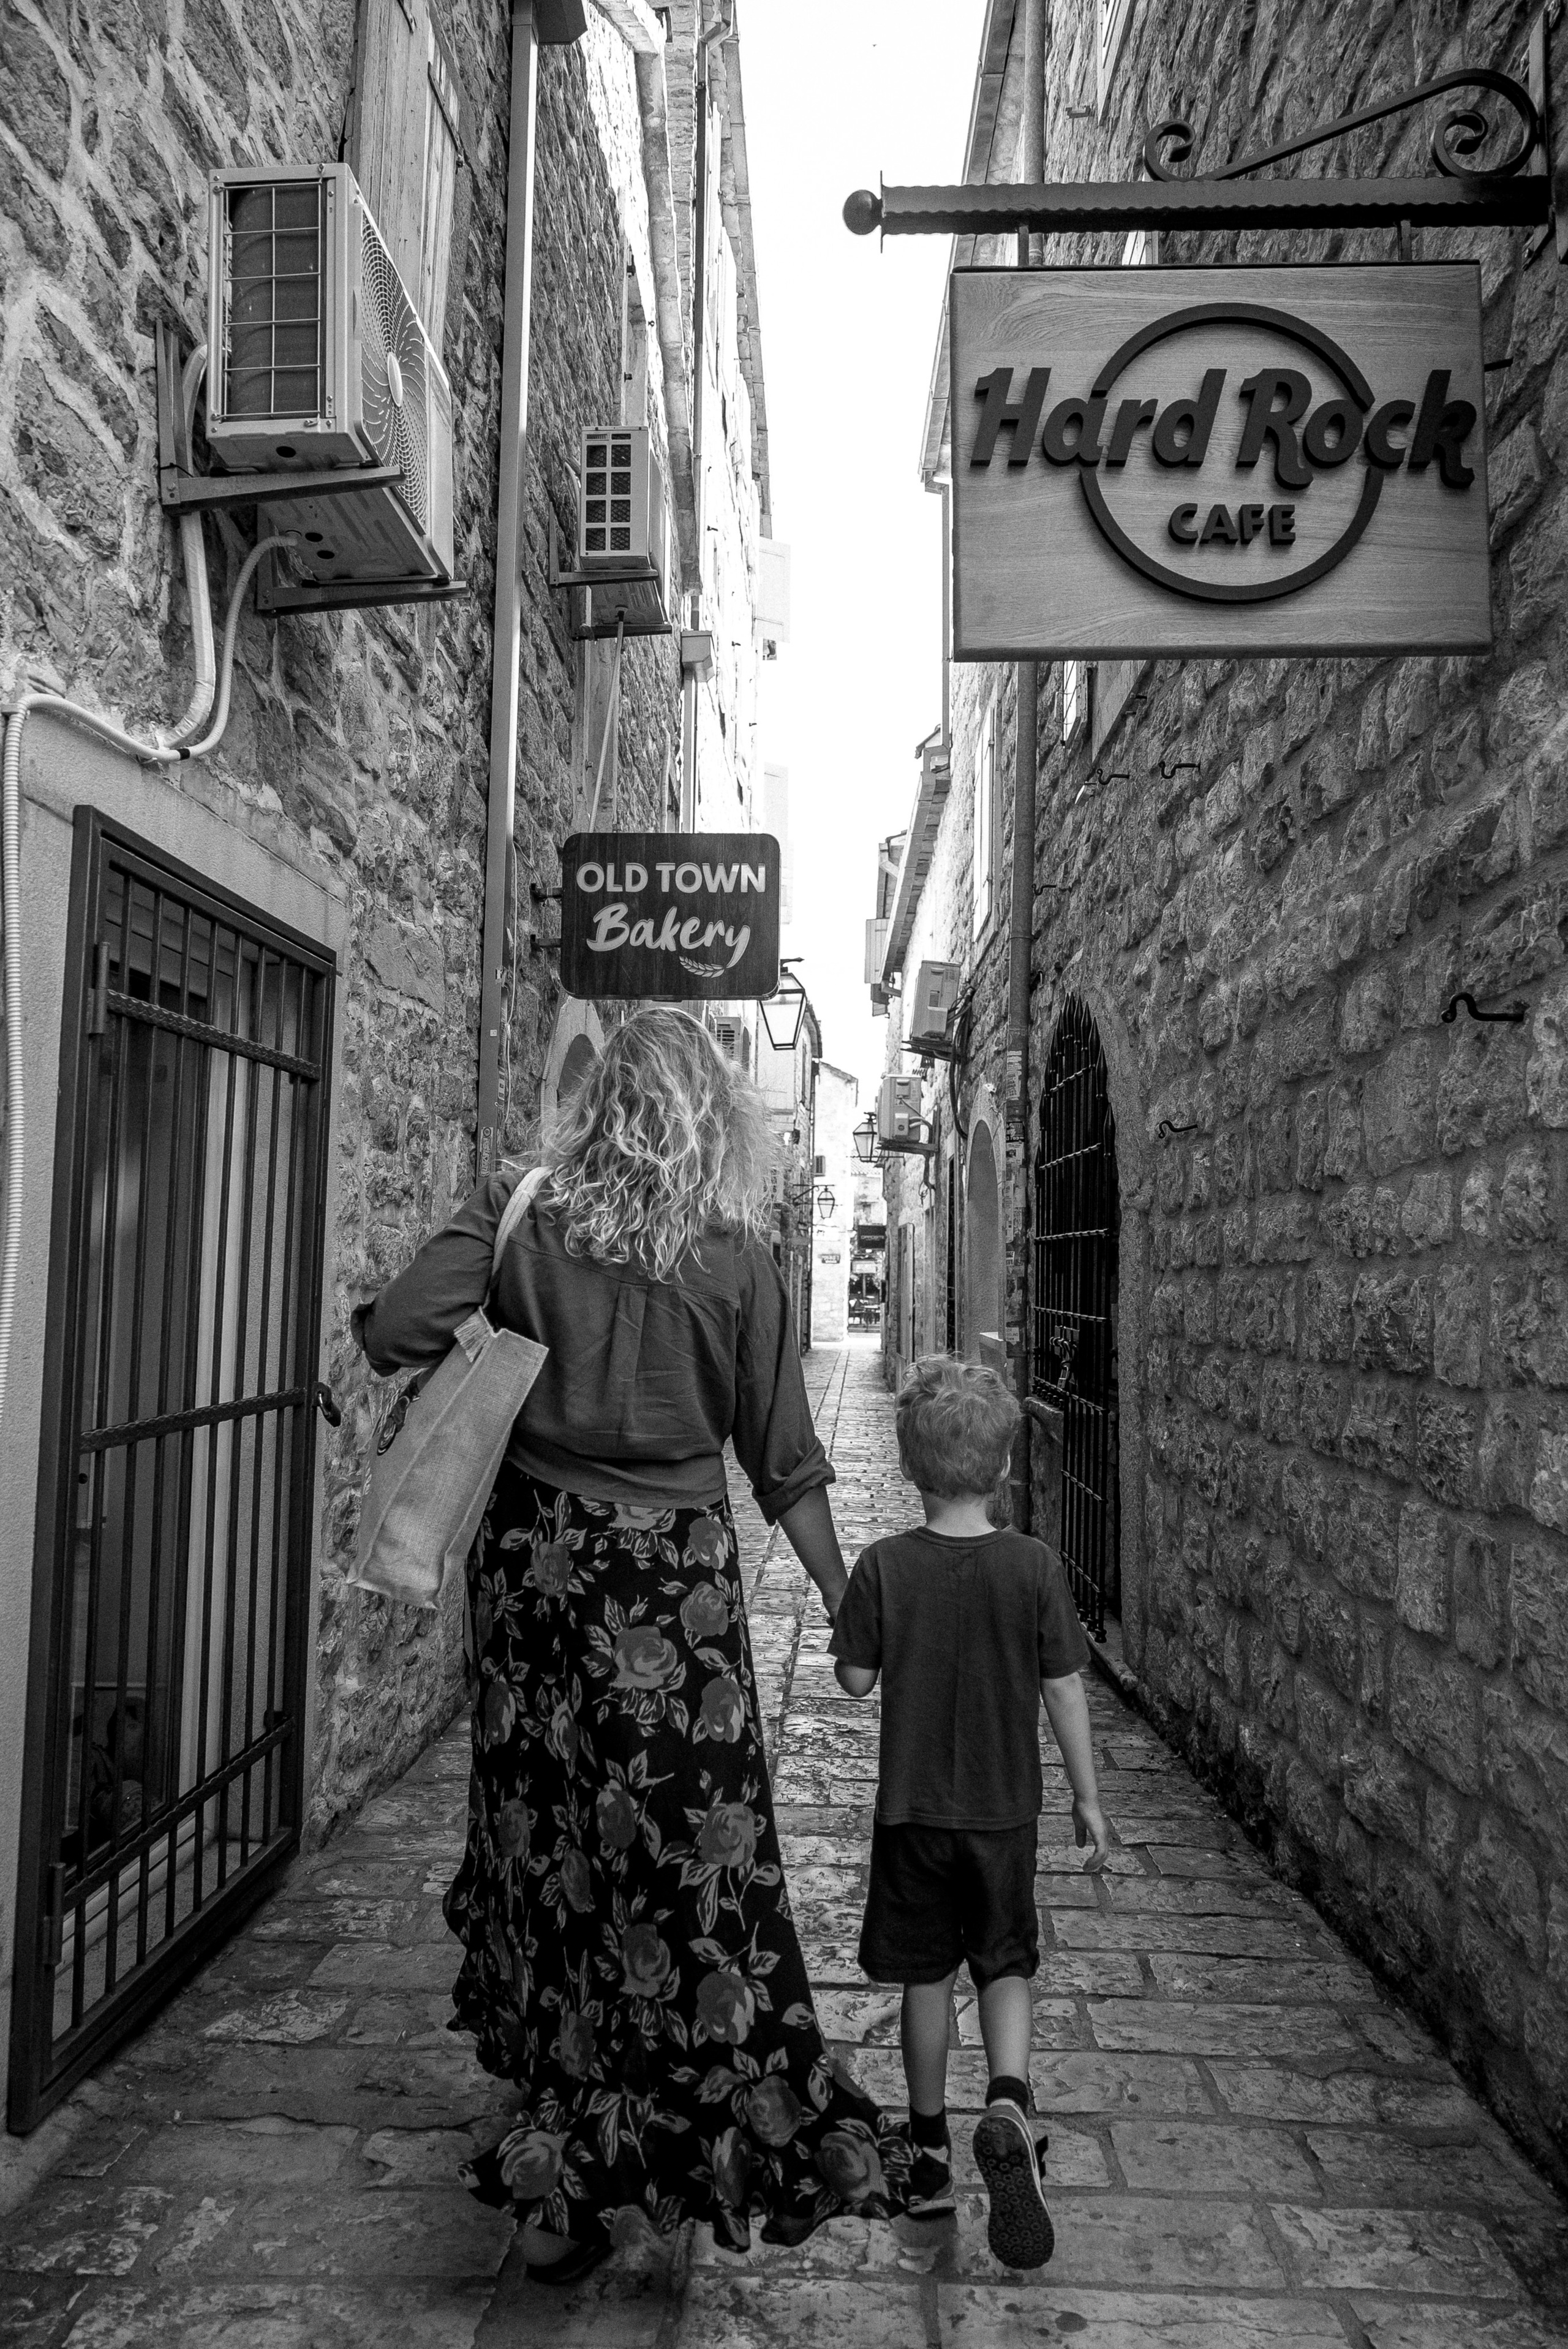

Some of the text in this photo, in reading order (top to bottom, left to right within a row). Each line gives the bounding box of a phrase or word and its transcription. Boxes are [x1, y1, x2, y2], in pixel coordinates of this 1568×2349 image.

[970, 367, 1478, 491] Hard Rock
[1167, 502, 1297, 547] CAFE
[576, 861, 766, 893] OLD TOWN
[586, 902, 751, 969] Bakery
